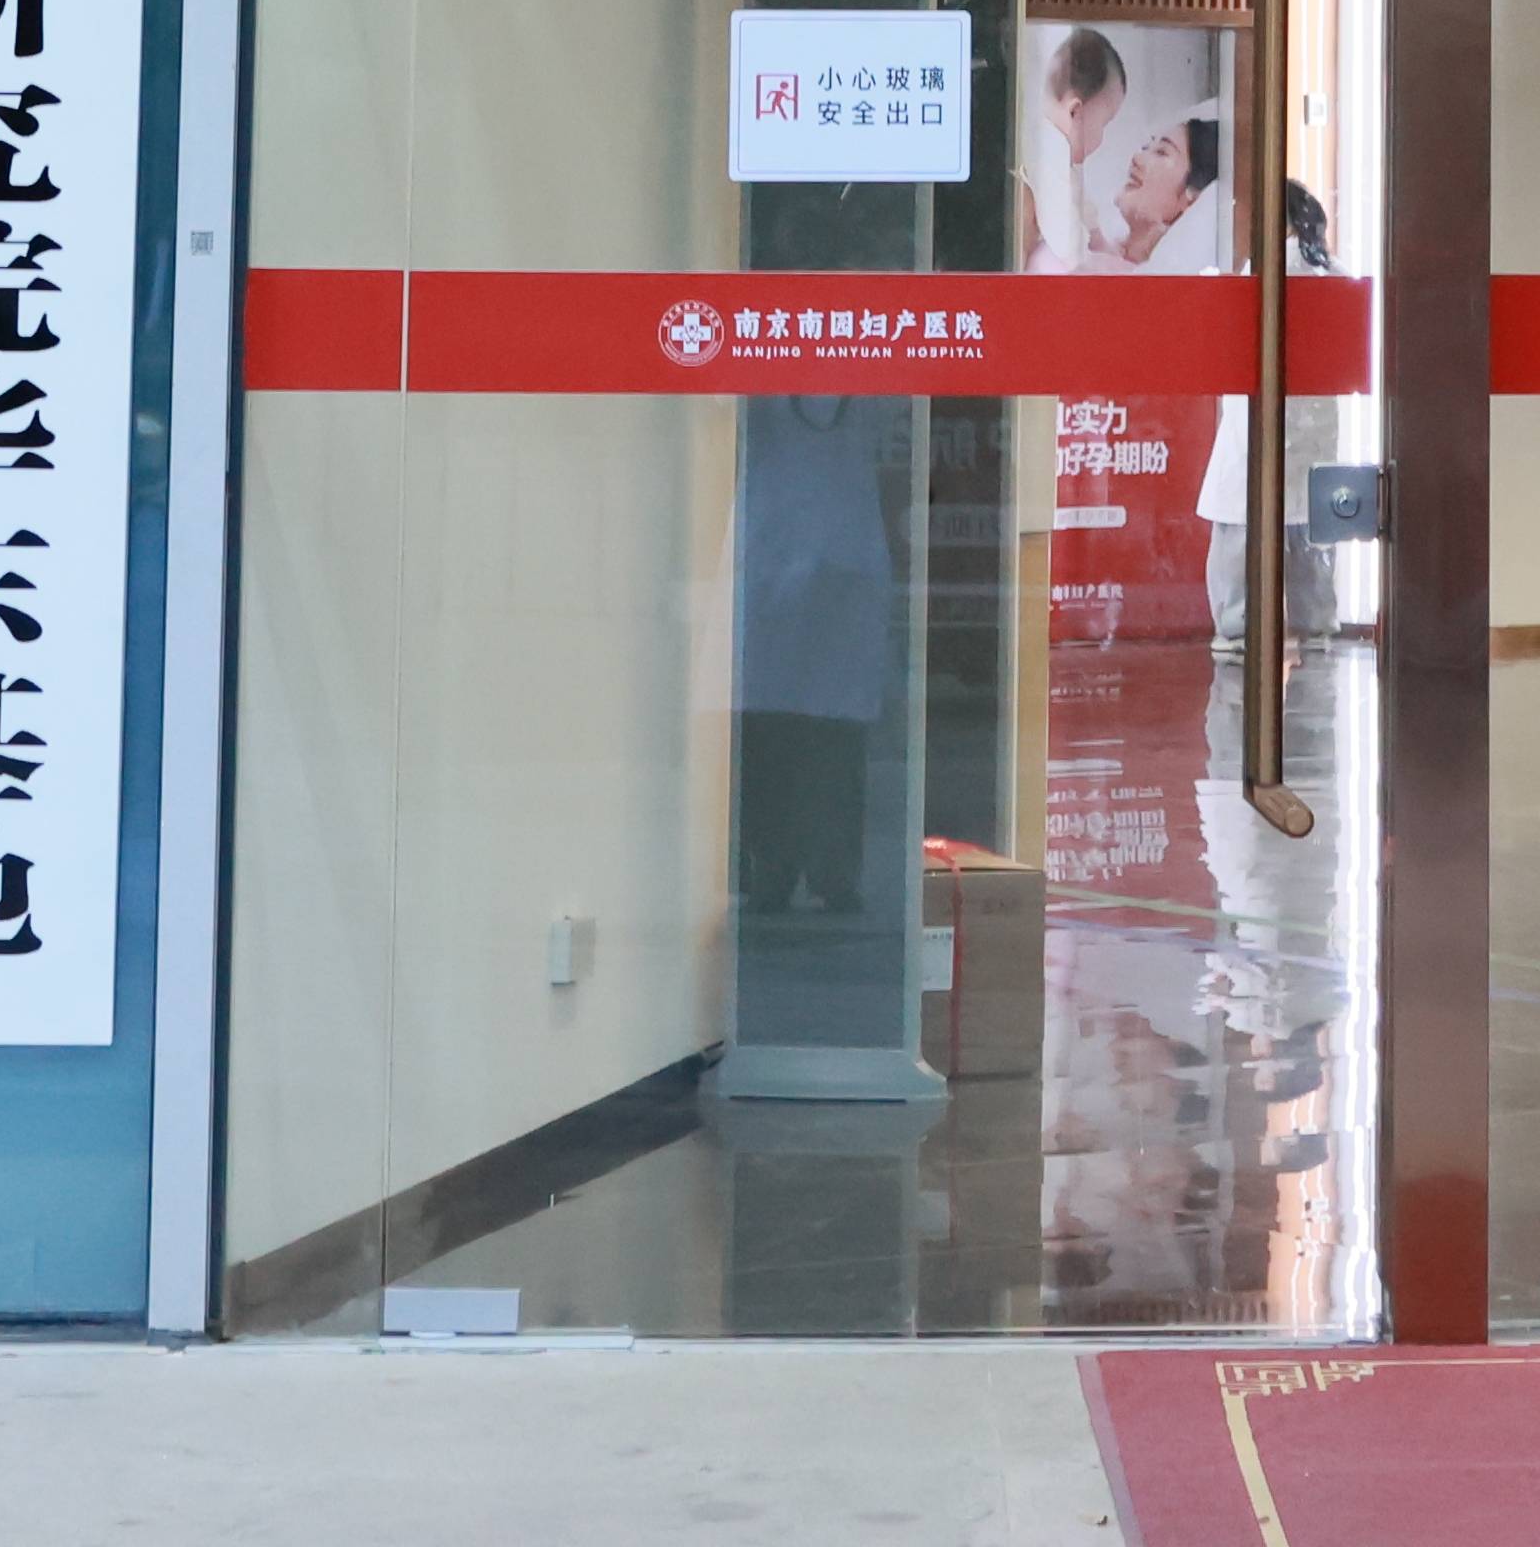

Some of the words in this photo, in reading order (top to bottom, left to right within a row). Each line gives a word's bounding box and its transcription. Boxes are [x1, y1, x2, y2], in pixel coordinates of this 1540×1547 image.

[818, 66, 944, 91] 小心玻璃
[818, 101, 942, 125] 安全出口
[733, 308, 984, 340] 南京南园妇产医院
[732, 346, 801, 360] NANJING
[816, 346, 892, 358] NANYUAN
[907, 346, 984, 358] HOSPITAL
